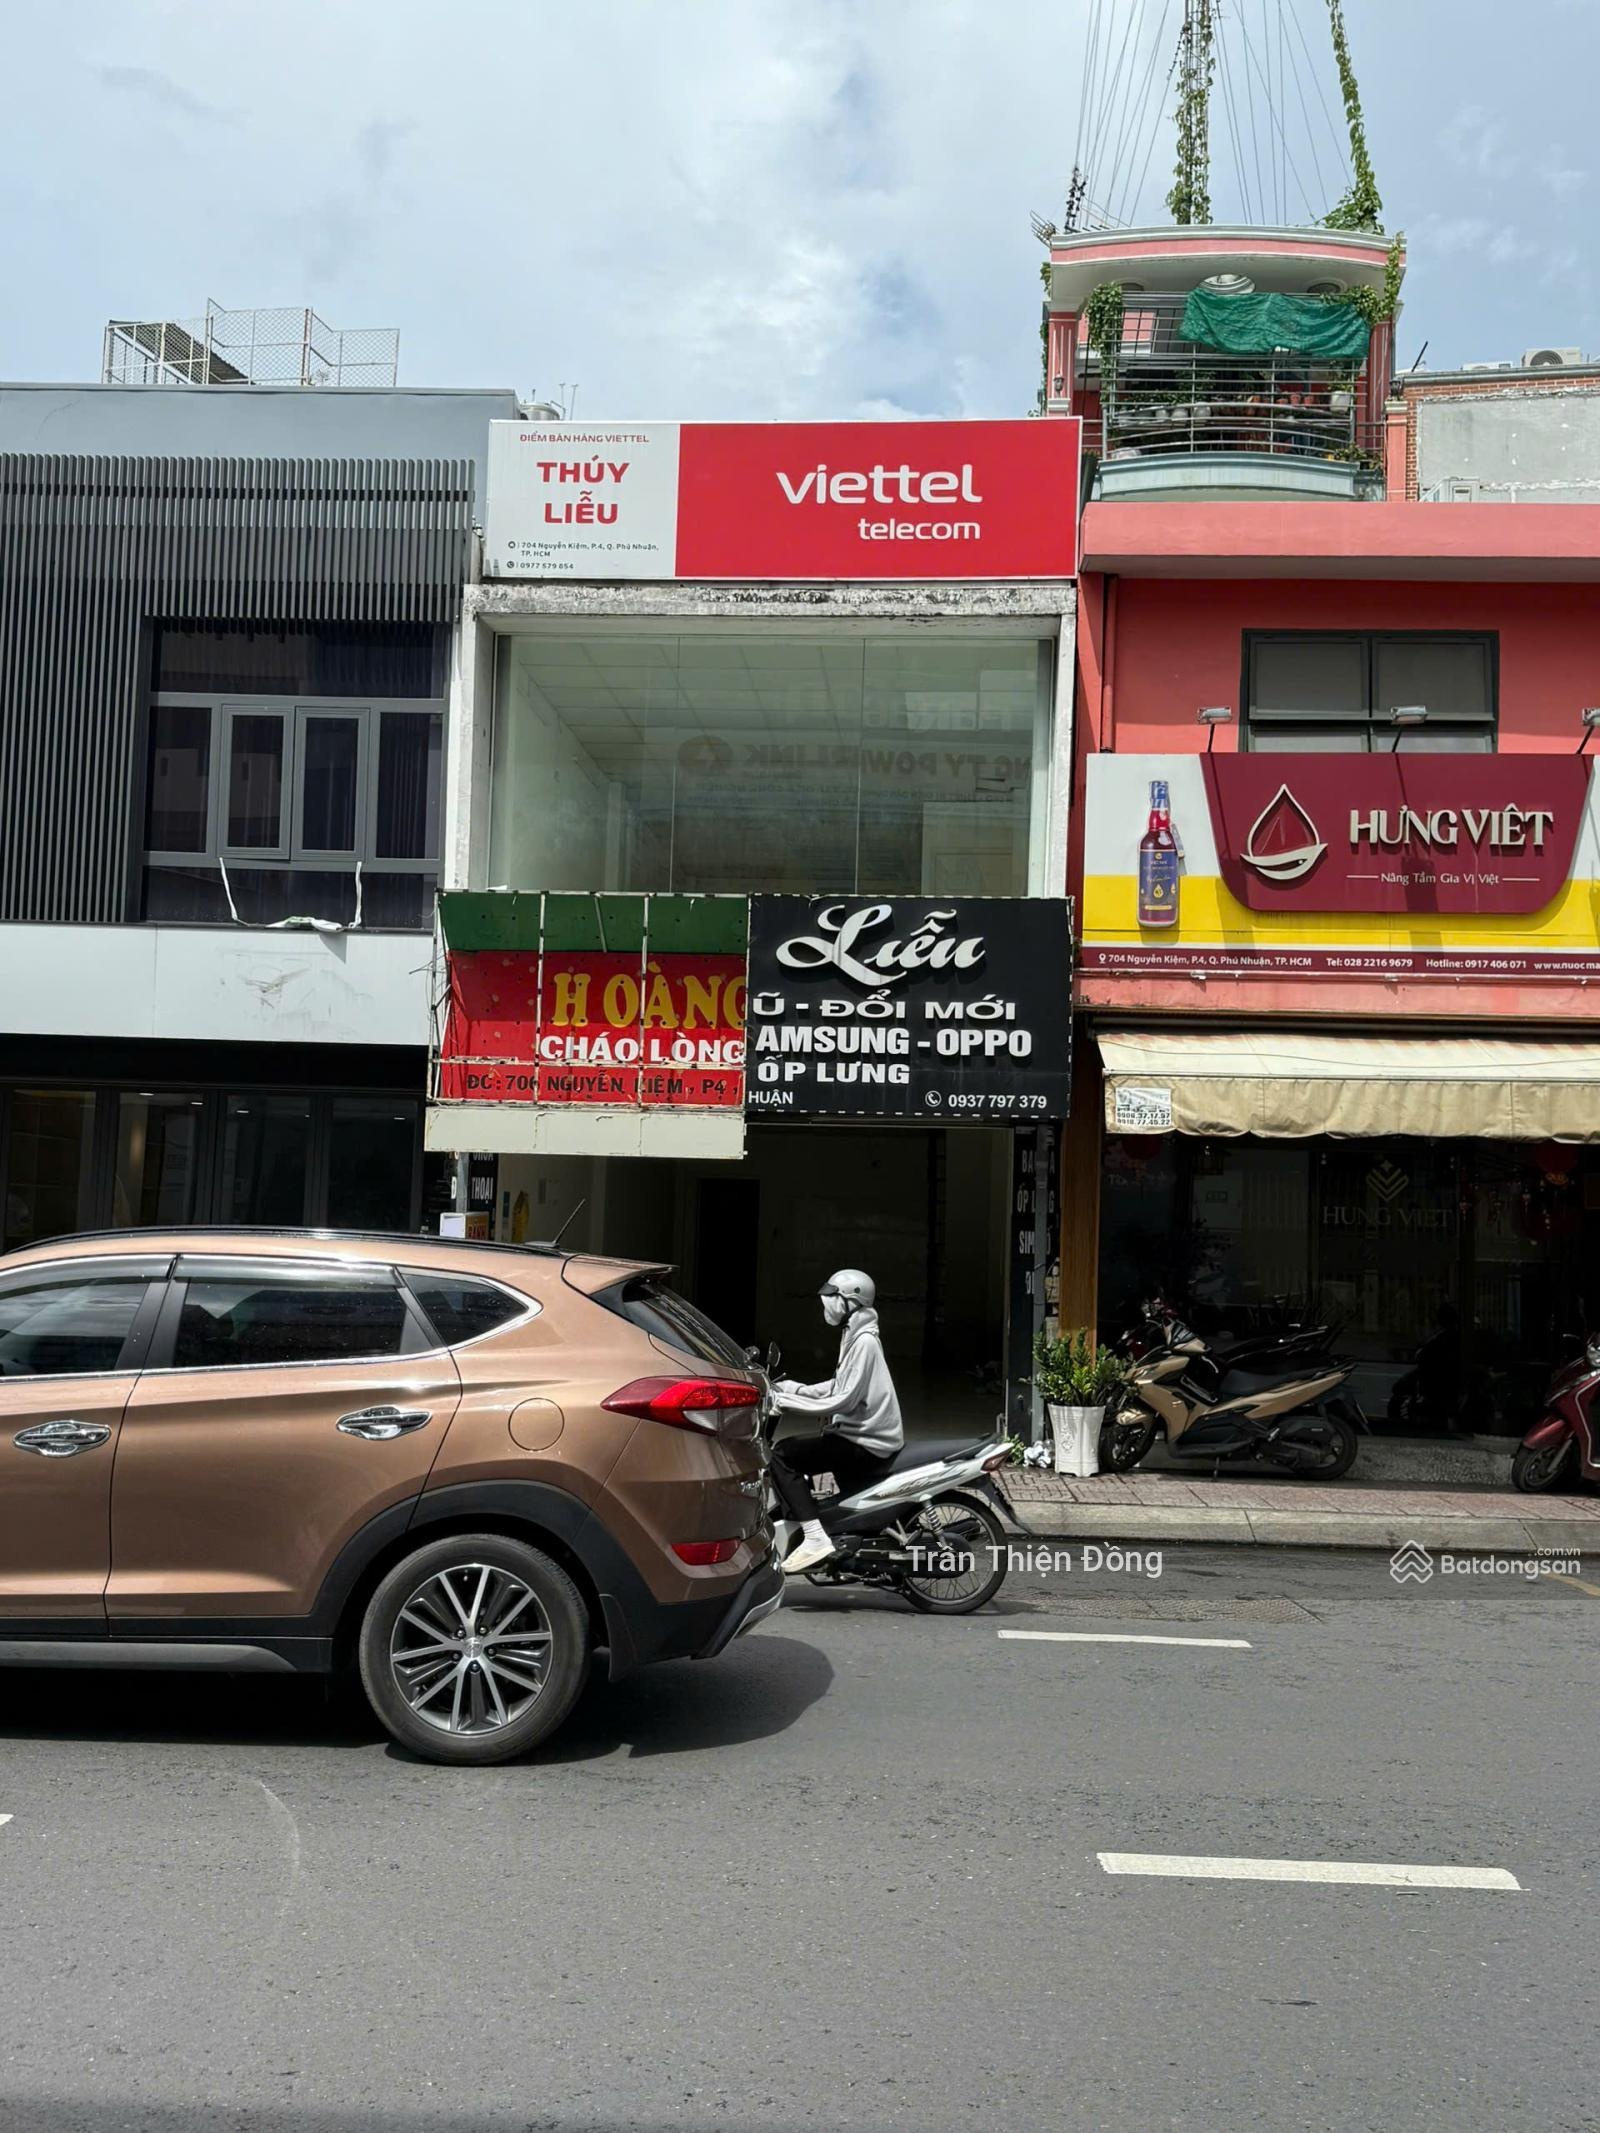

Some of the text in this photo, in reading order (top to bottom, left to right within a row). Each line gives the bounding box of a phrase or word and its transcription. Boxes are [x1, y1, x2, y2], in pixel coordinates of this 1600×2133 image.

[604, 434, 650, 443] VIETTEL
[536, 454, 630, 483] THÚY
[775, 463, 983, 504] viettel
[544, 490, 618, 524] LIỄU
[858, 518, 981, 540] telecom
[1349, 804, 1459, 845] HƯNG
[1380, 872, 1410, 885] Nâng
[1440, 872, 1460, 884] Gia
[1462, 873, 1475, 885] Vị
[1478, 874, 1500, 885] Việt
[776, 904, 986, 986] Liễu
[1108, 954, 1126, 963] 704
[1127, 954, 1162, 966] Nguyễn
[1164, 955, 1190, 966] Kiệm,
[1191, 956, 1207, 966] P.4,
[1208, 956, 1219, 966] Q.
[1240, 956, 1273, 967] Nhuận,
[1274, 957, 1288, 966] TP.
[1290, 957, 1312, 967] HCM
[1326, 958, 1343, 967] Tel:
[1343, 958, 1362, 967] 028
[1363, 959, 1388, 968] 2216
[1388, 959, 1413, 968] 9679
[1426, 959, 1464, 968] Hotline:
[1465, 960, 1489, 969] 0917
[1490, 960, 1508, 969] 406
[1509, 960, 1528, 969] 071
[819, 988, 906, 1019] ĐỔI
[924, 994, 1016, 1020] MỚI
[539, 1032, 746, 1064] CHÁO LÒNG
[755, 1025, 910, 1055] AMSUNG
[936, 1028, 1032, 1057] OPPO
[506, 1074, 540, 1092] 706
[546, 1070, 623, 1094] NGUYỄN
[757, 1054, 910, 1084] ỐP LƯNG
[748, 1088, 1048, 1109] HUẬN 0937 797 379
[471, 1176, 494, 1204] THOẠI
